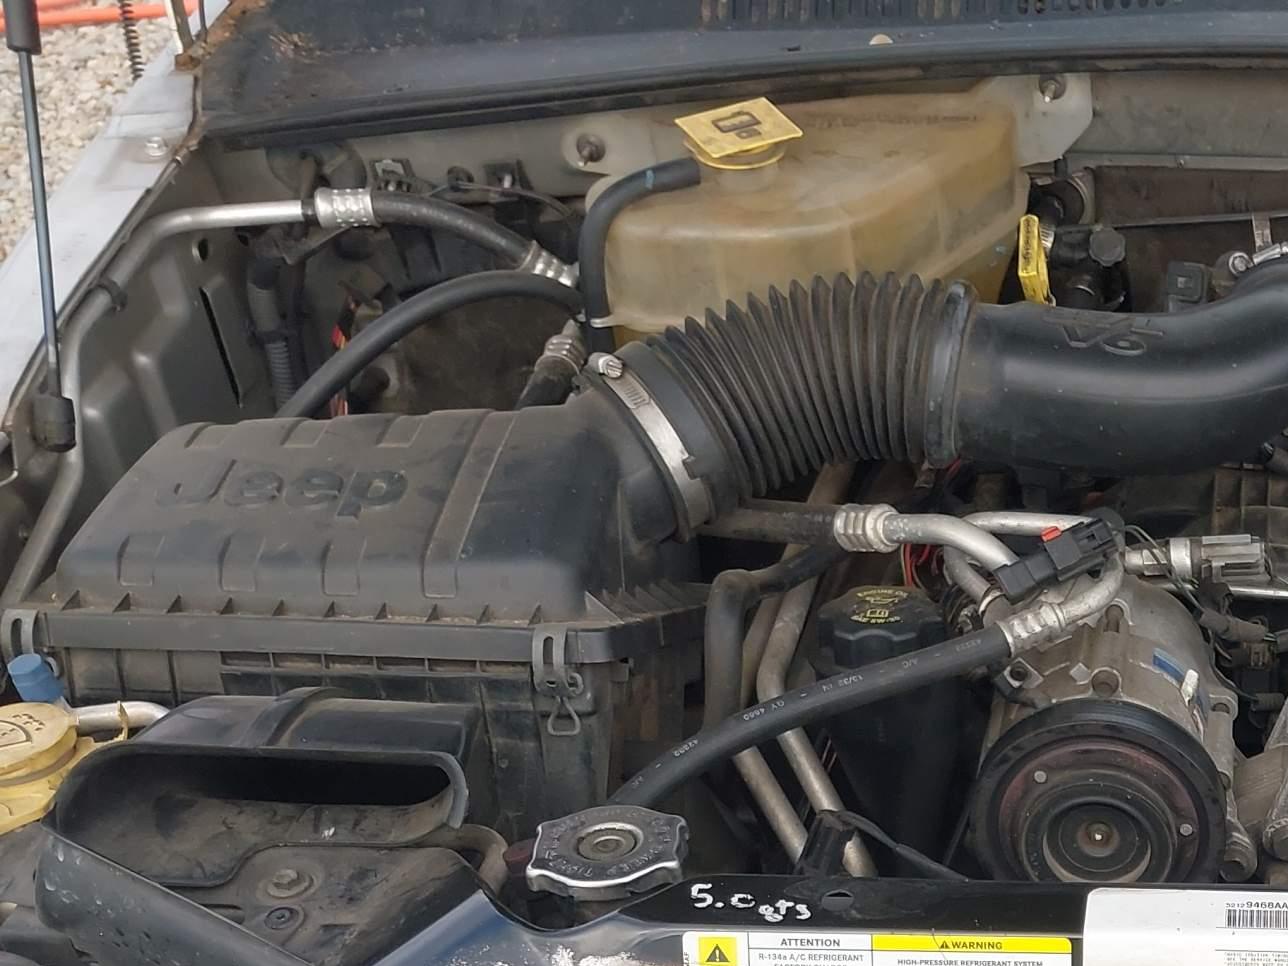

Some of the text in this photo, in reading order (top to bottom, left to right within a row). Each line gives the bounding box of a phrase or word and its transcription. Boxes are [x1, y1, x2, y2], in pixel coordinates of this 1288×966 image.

[156, 458, 408, 519] Jeep
[780, 938, 841, 948] ATTENTION
[951, 941, 1003, 950] WARNING
[758, 953, 864, 963] R-134a A/C REFRIGERANT
[897, 959, 959, 966] HIGH-PRESSURE
